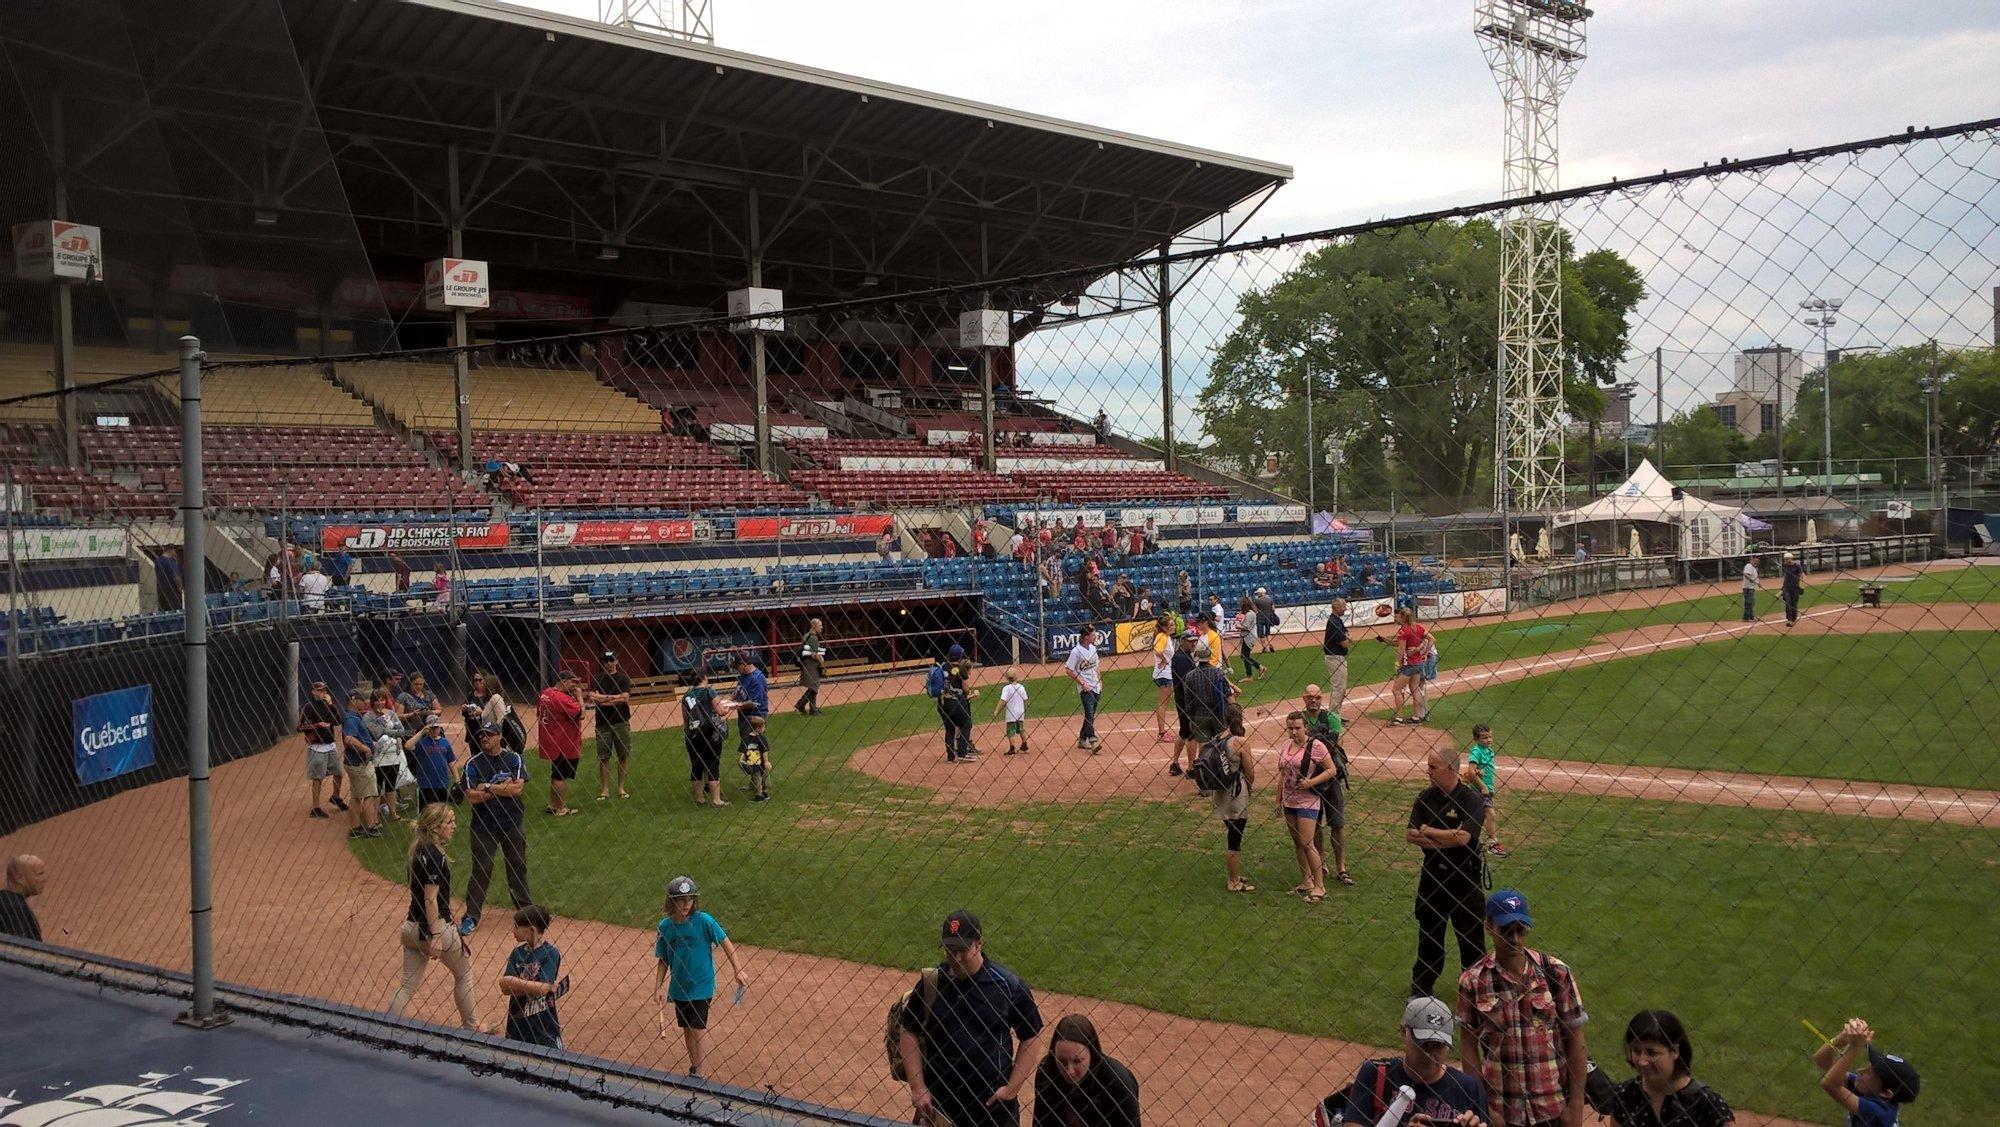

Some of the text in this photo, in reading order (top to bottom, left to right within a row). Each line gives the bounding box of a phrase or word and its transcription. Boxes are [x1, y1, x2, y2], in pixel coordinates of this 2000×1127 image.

[454, 285, 477, 293] GROUPE
[387, 526, 491, 539] JD CHRYSLER FIAT
[631, 525, 649, 533] Jeep
[387, 538, 451, 548] DE BOISCHATE
[1053, 634, 1081, 649] PMT
[81, 721, 131, 756] Québec
